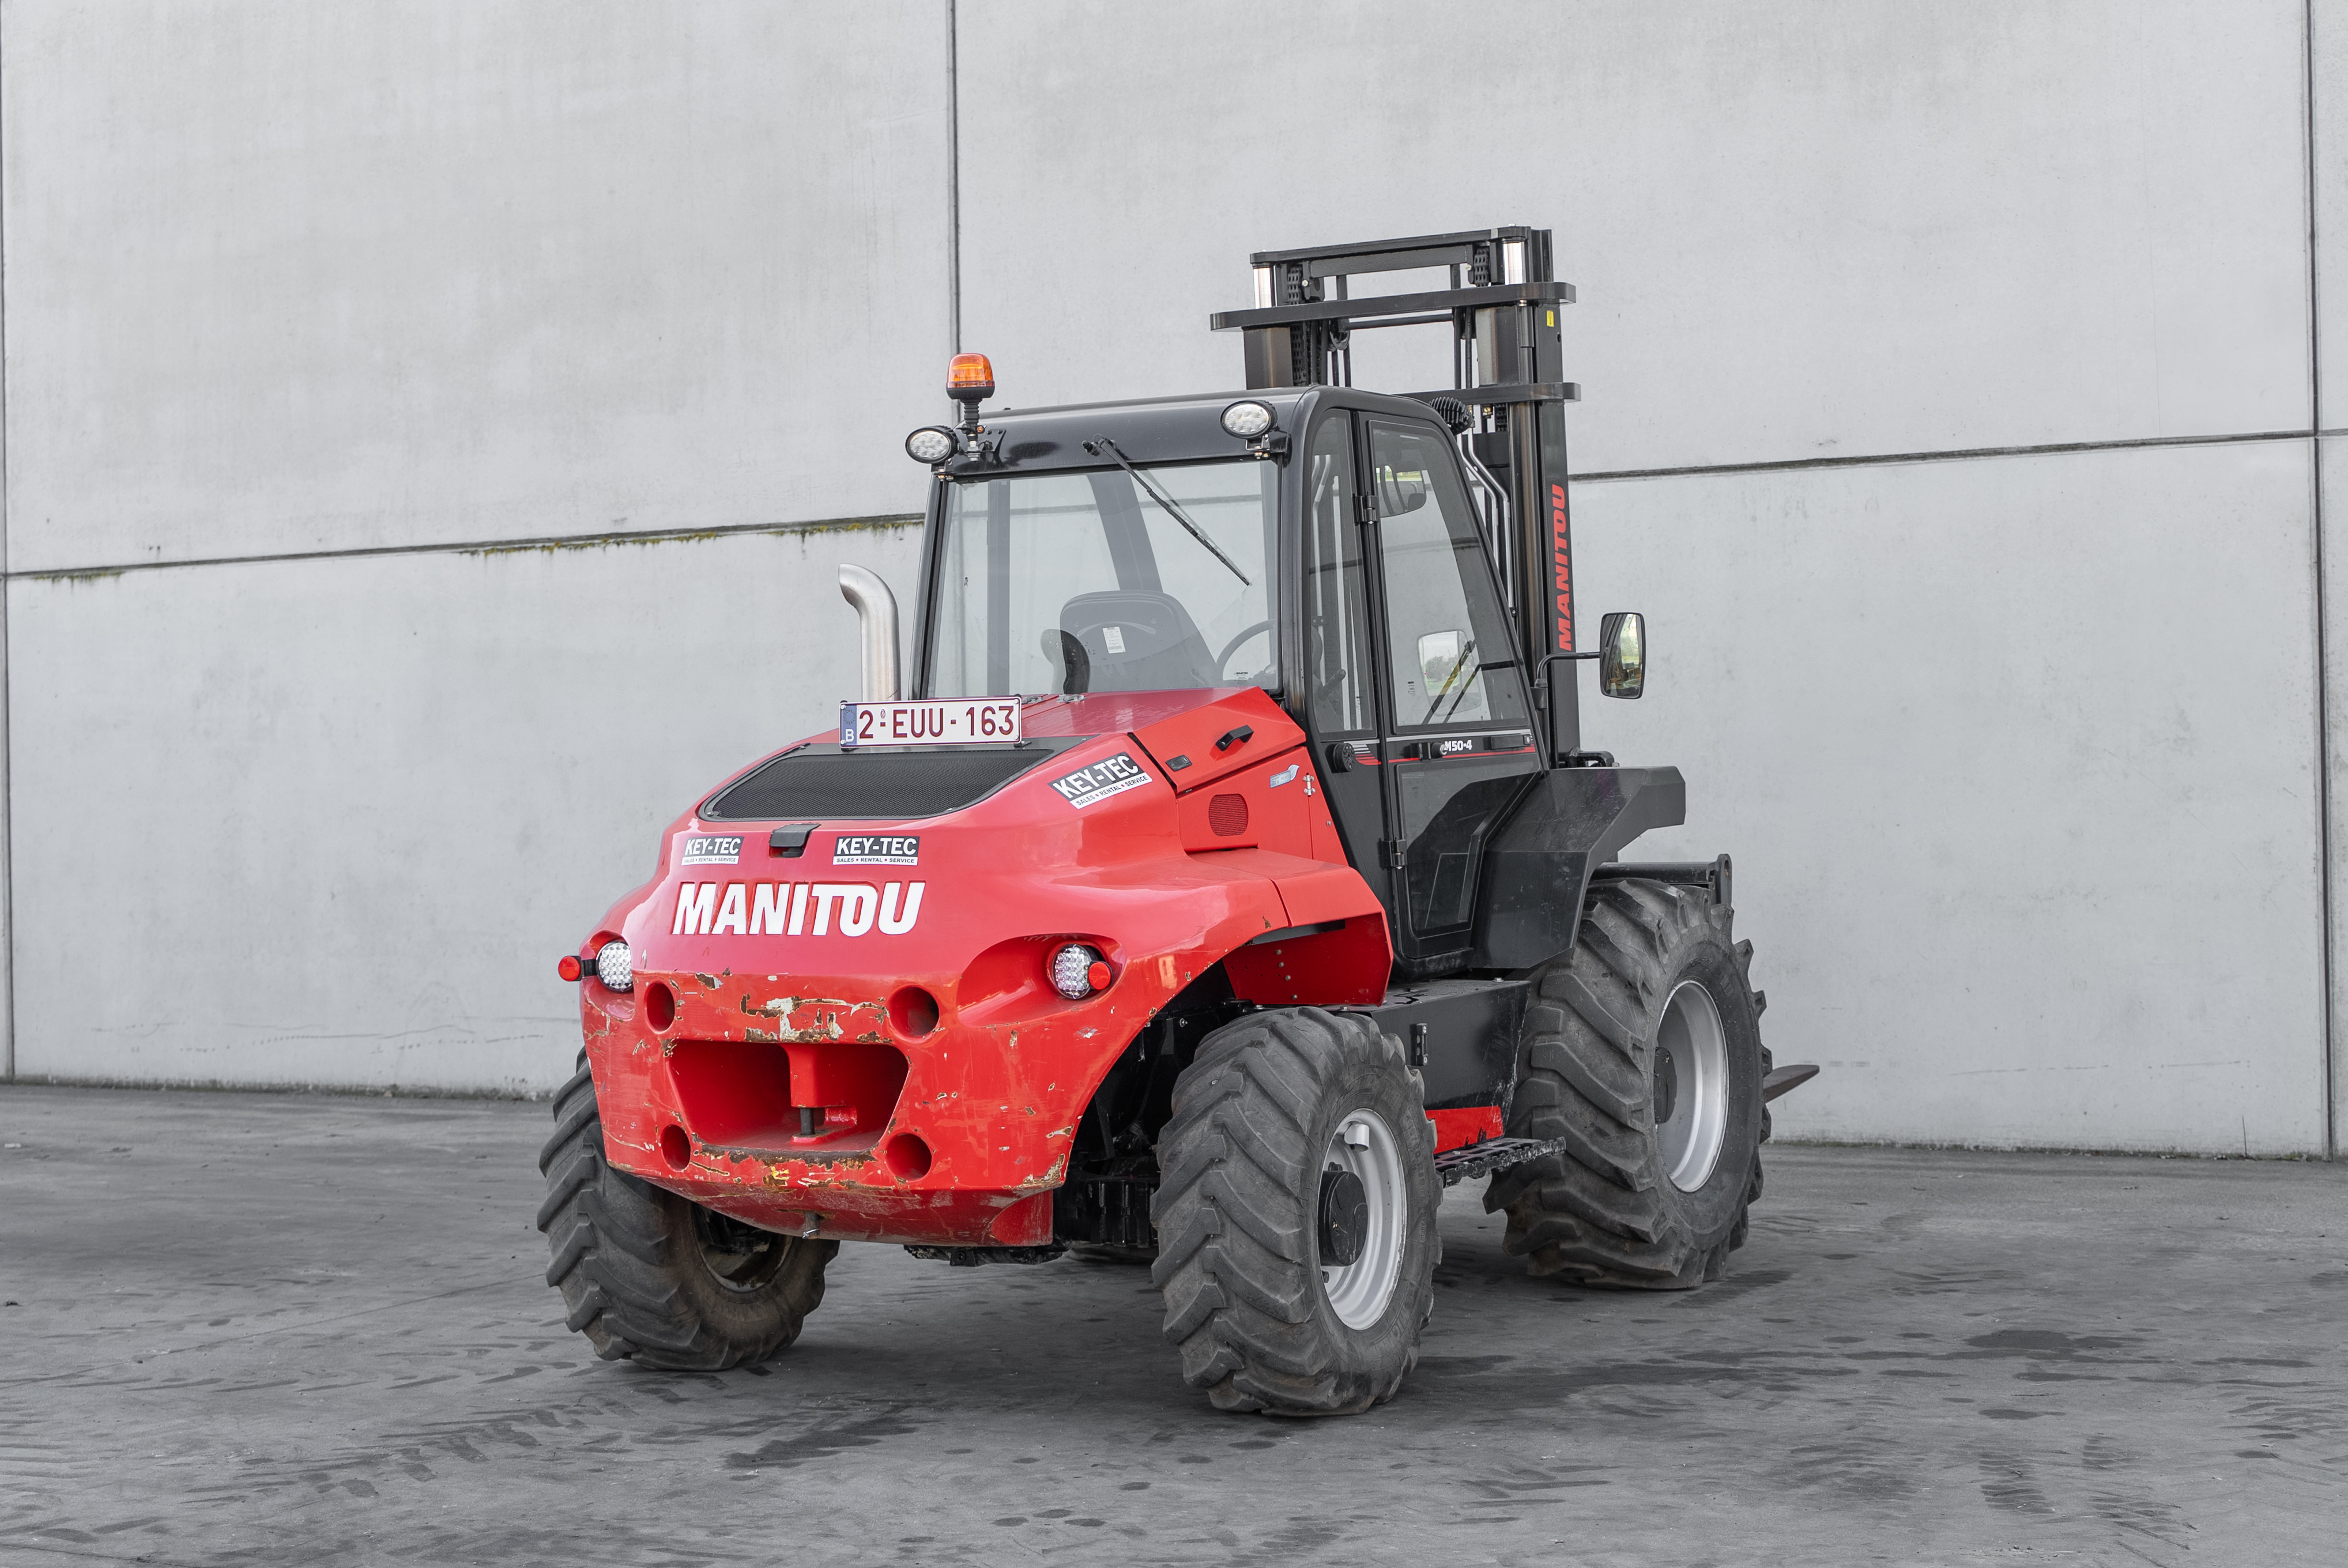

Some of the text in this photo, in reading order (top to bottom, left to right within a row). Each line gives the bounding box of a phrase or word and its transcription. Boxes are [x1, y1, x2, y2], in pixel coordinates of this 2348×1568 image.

[1552, 484, 1572, 651] MANITOU
[845, 728, 854, 742] B
[1052, 755, 1139, 799] KEY-TEC
[1076, 775, 1148, 805] SALES RENTAL SERVICE
[684, 838, 741, 855] KEY-TEC
[836, 838, 917, 855] KEY-TEC
[672, 882, 925, 937] MANITOU
